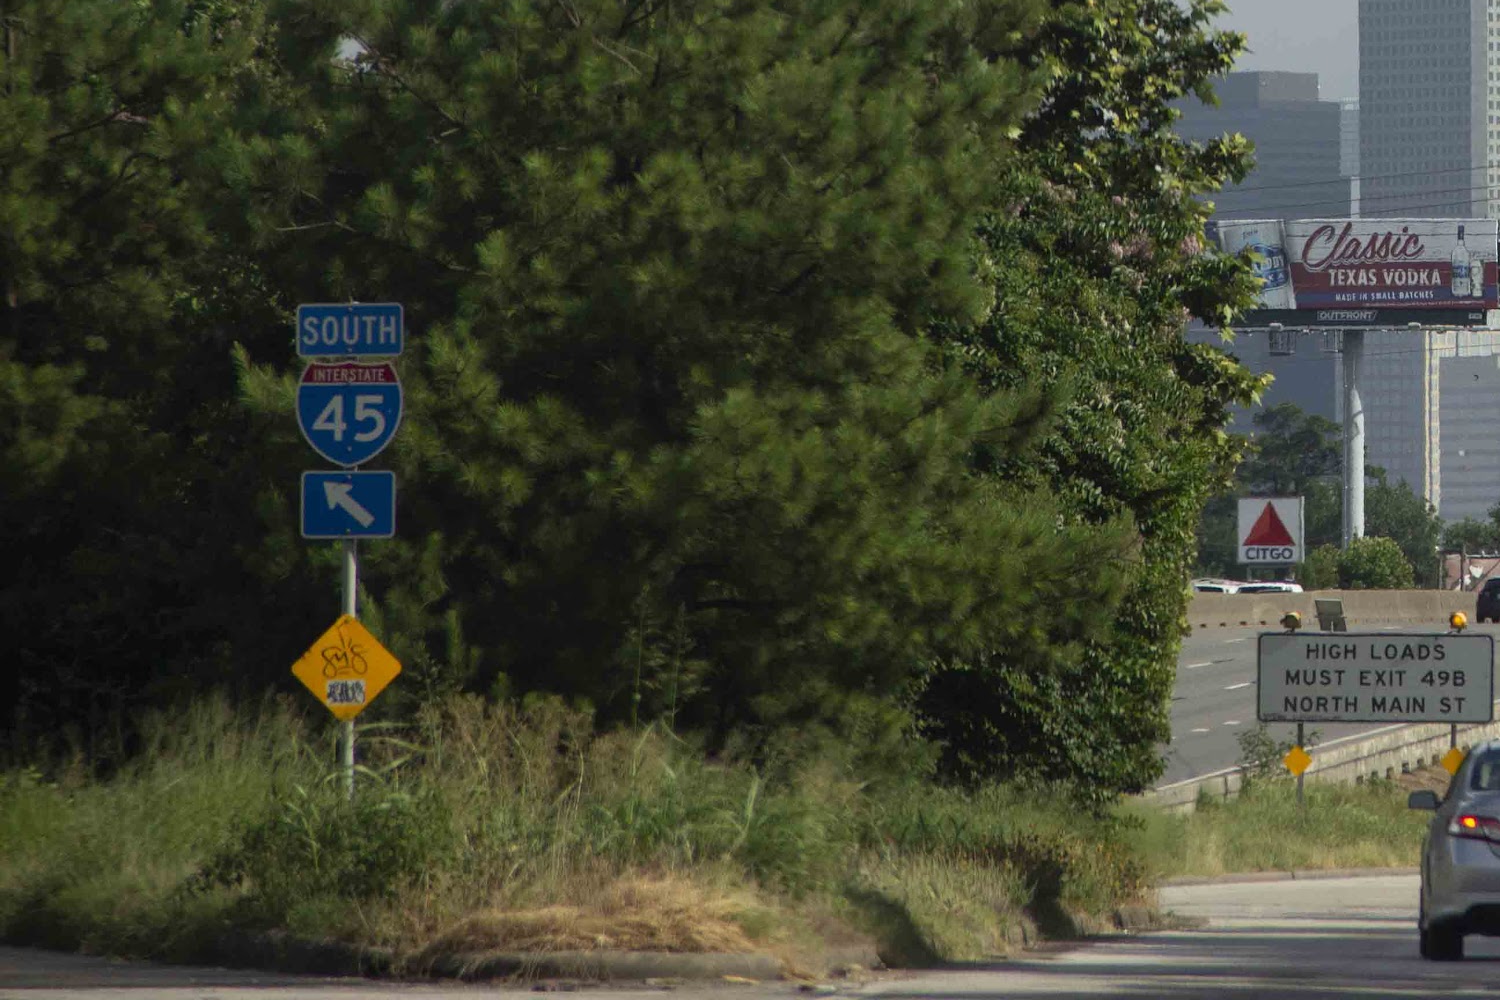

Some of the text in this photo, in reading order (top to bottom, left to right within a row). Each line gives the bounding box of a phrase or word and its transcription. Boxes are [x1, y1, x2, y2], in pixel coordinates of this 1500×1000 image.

[1302, 222, 1424, 269] Classic
[1328, 268, 1377, 286] TEXAS
[1382, 268, 1441, 286] VODKA
[1335, 290, 1434, 302] MADE IN SMALL BATCHES
[1319, 310, 1375, 320] OUTFRONT
[303, 316, 397, 346] SOUTH
[313, 368, 386, 382] INTERSTATE
[312, 394, 386, 442] 45
[1246, 547, 1294, 560] CITGO
[1306, 644, 1446, 660] HIGH LOADS
[1285, 670, 1466, 687] MUST EXIT 49B
[1284, 697, 1467, 713] NORTH MAIN ST
